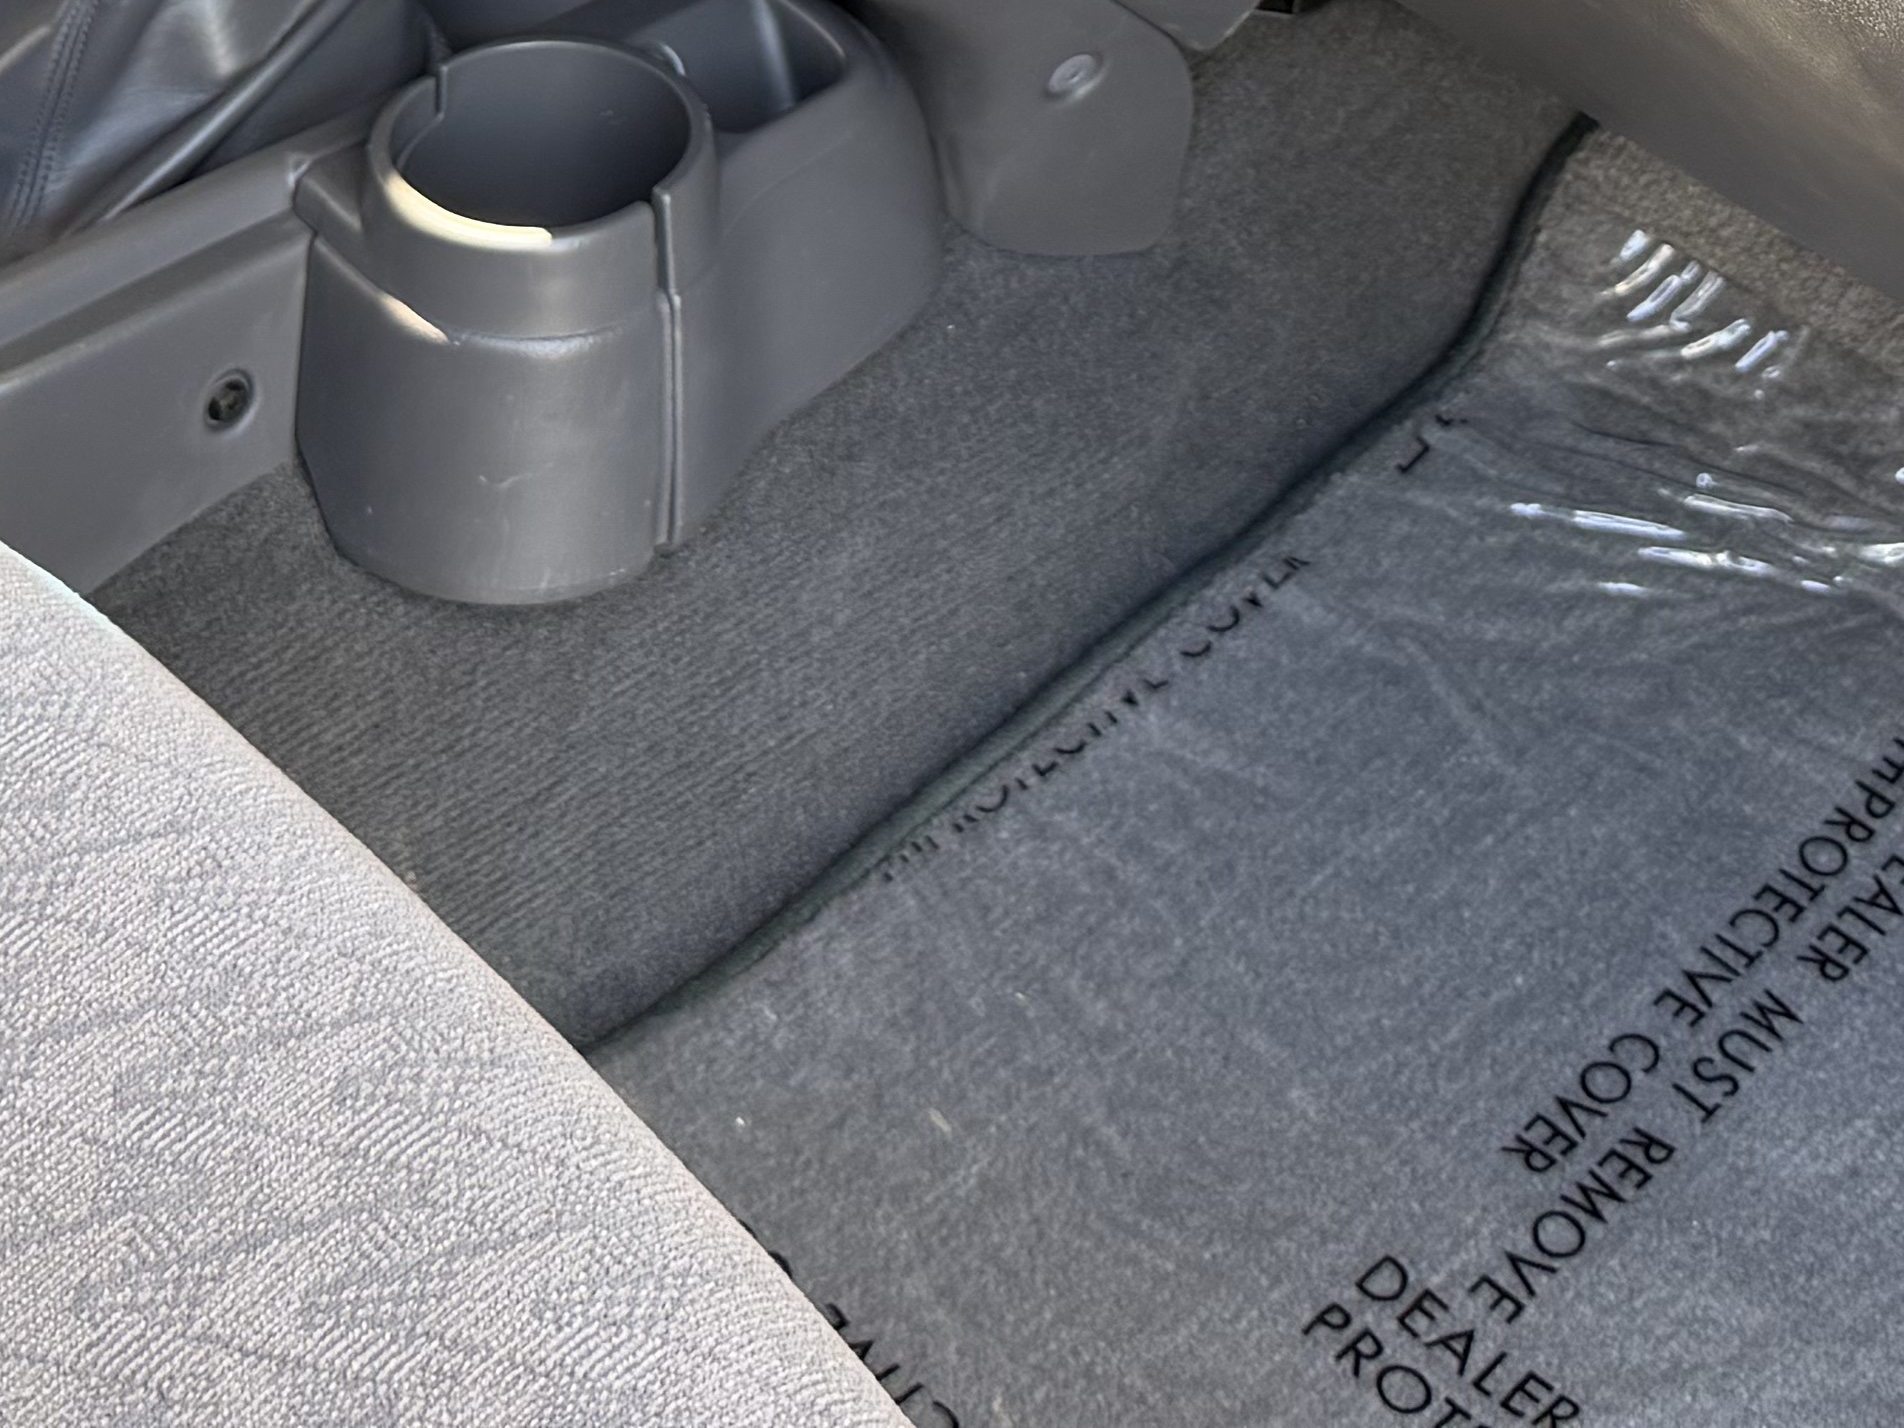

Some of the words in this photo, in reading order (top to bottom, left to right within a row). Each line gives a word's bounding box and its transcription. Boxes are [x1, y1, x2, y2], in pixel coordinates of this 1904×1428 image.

[1652, 779, 1896, 1028] PROTECTIVE
[1501, 1032, 1662, 1174] COVER
[1672, 989, 1805, 1125] MUST
[1468, 1127, 1677, 1324] REMOVE
[1301, 1301, 1488, 1428] PROT
[1355, 1254, 1583, 1428] DEALER
